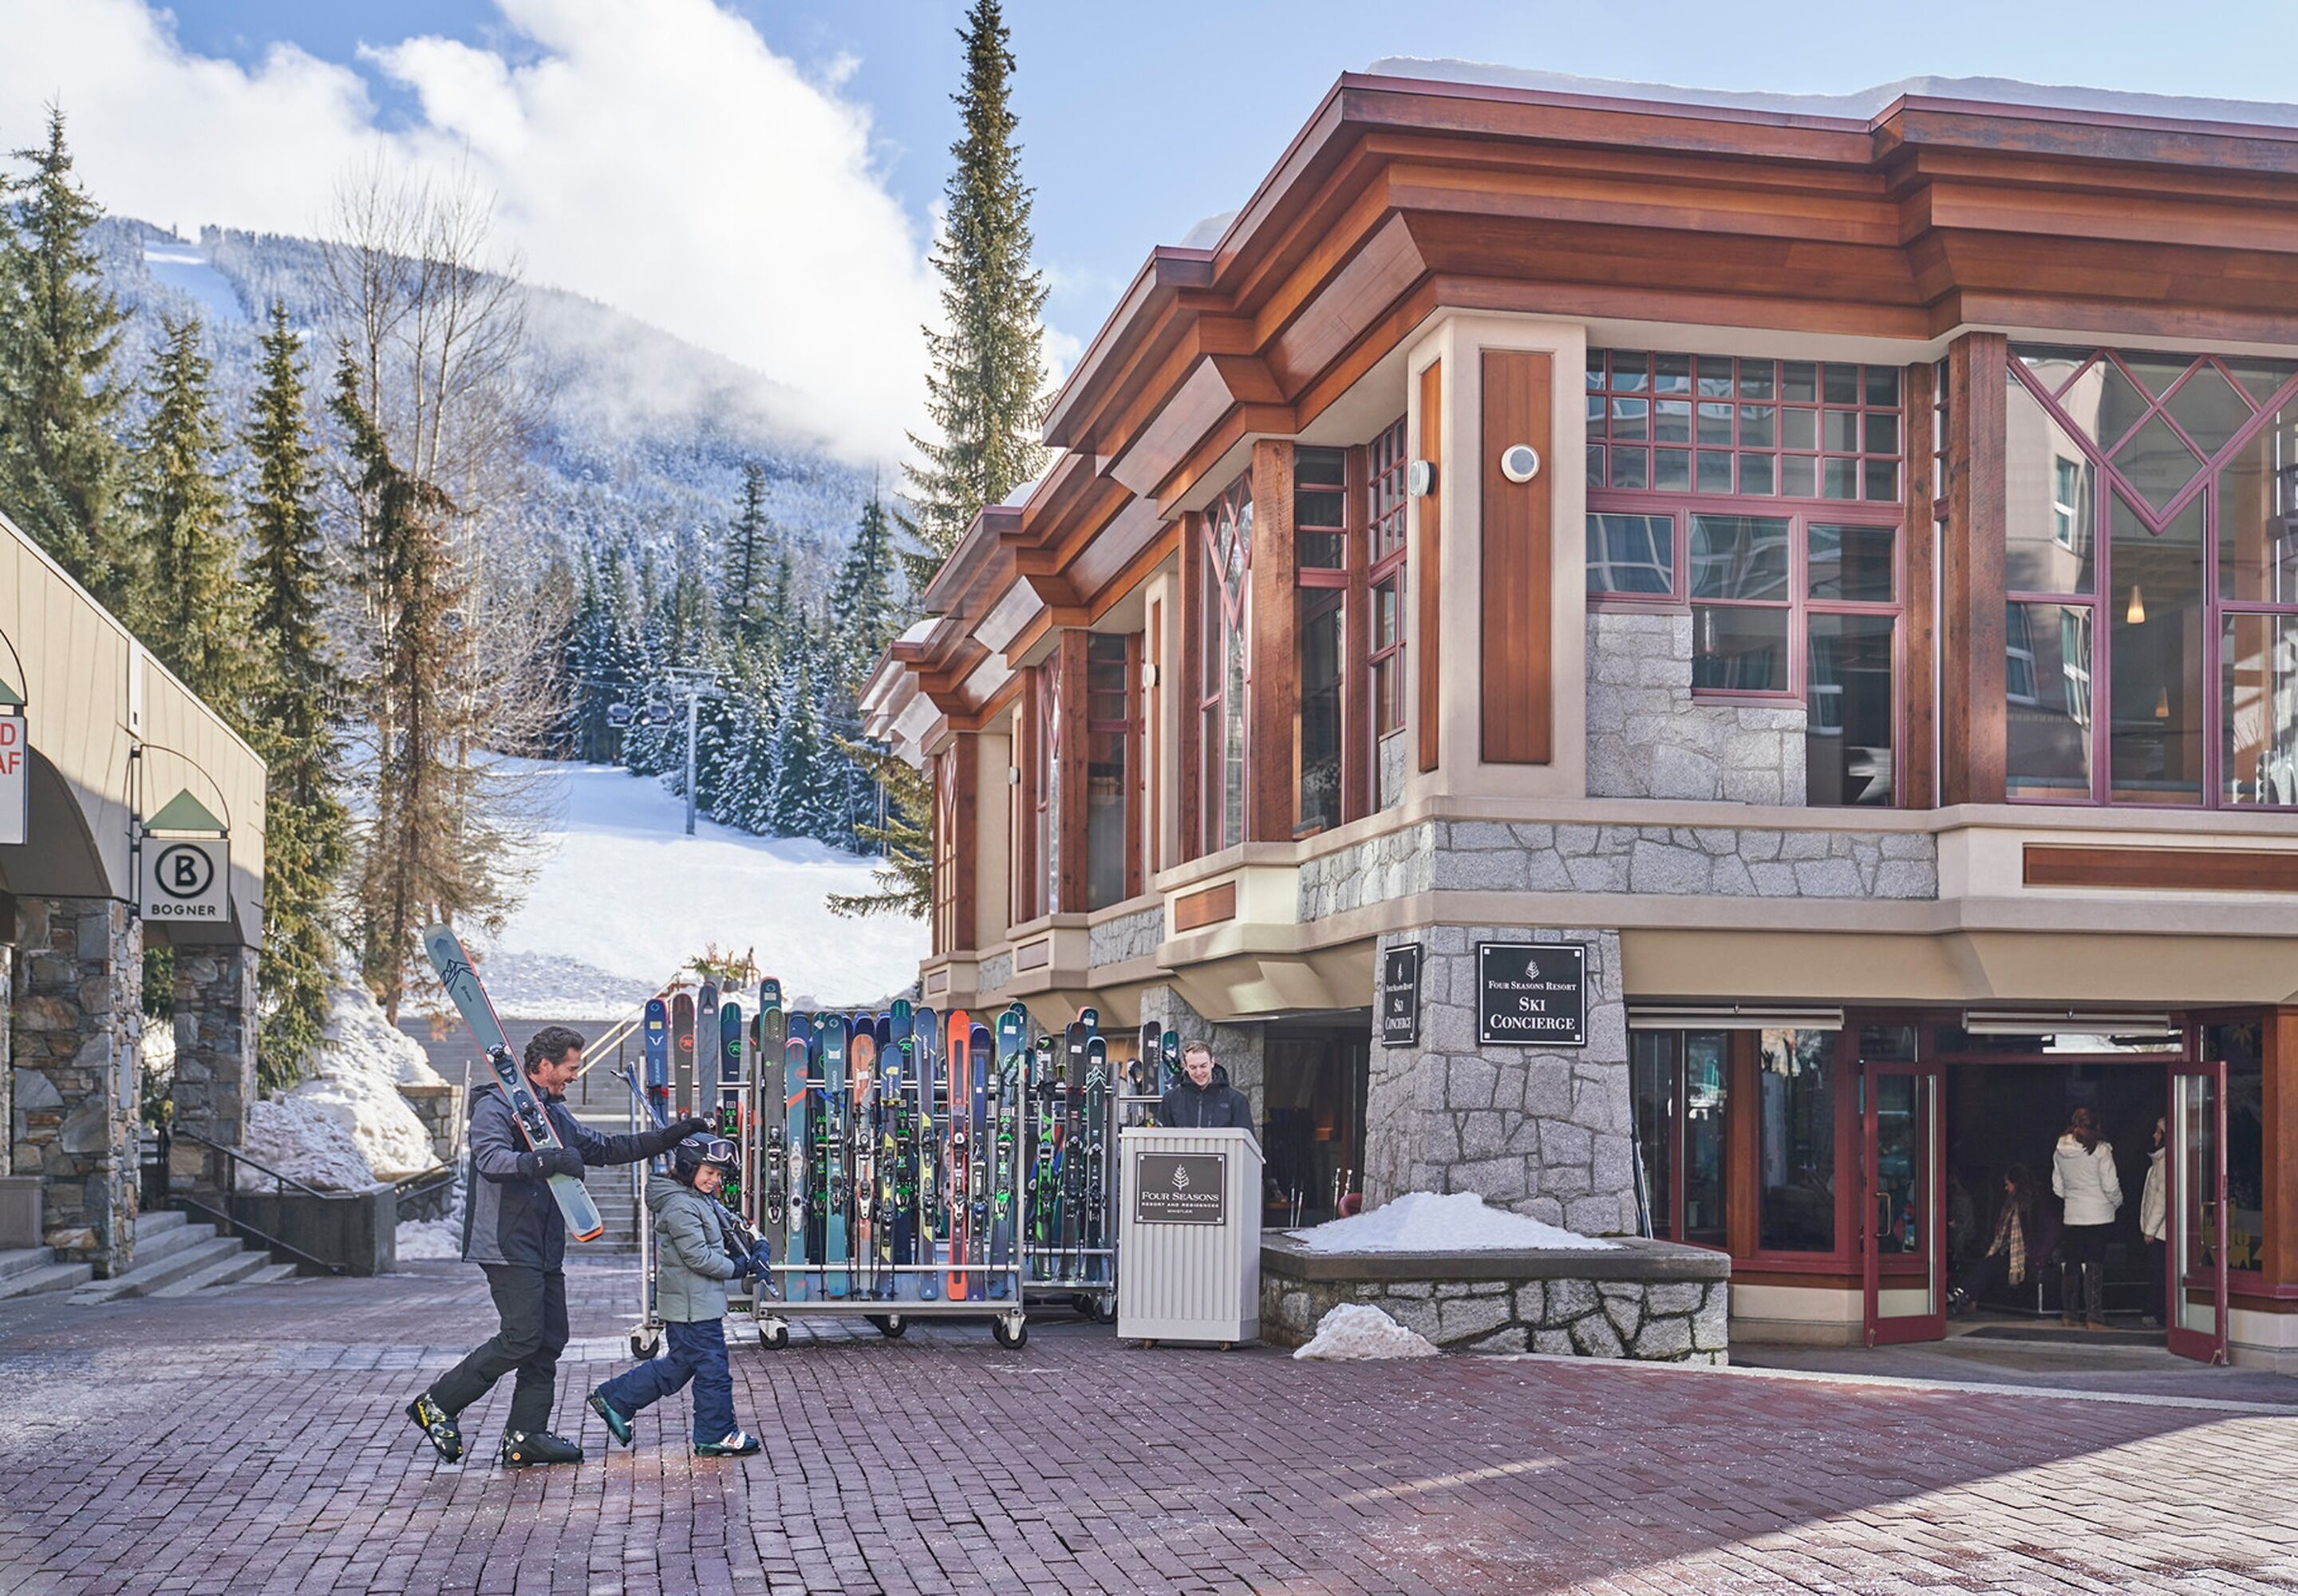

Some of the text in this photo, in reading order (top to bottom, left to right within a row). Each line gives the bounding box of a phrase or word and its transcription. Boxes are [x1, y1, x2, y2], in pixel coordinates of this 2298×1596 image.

[151, 903, 216, 916] BOGNER
[1488, 980, 1577, 991] FOUR SEASONS RESORT
[1518, 996, 1546, 1012] SKI
[1490, 1013, 1576, 1030] CONCIERGE
[1142, 1191, 1219, 1201] FOUR SEASONS
